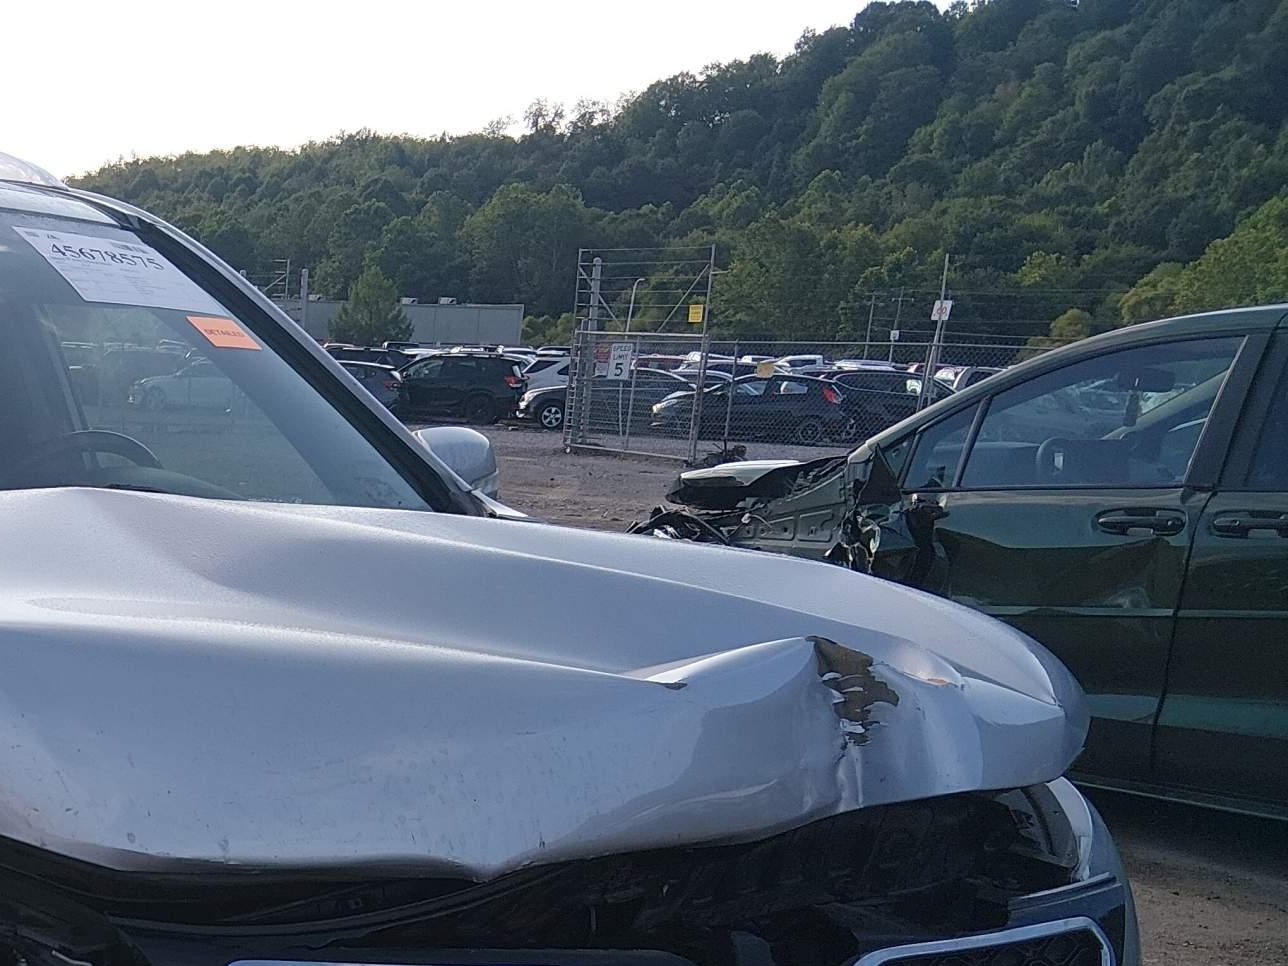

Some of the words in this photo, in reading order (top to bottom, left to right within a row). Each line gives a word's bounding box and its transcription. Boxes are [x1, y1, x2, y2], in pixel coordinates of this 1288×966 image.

[51, 243, 165, 271] 45678575
[613, 353, 629, 361] LIMIT
[614, 362, 624, 377] 5
